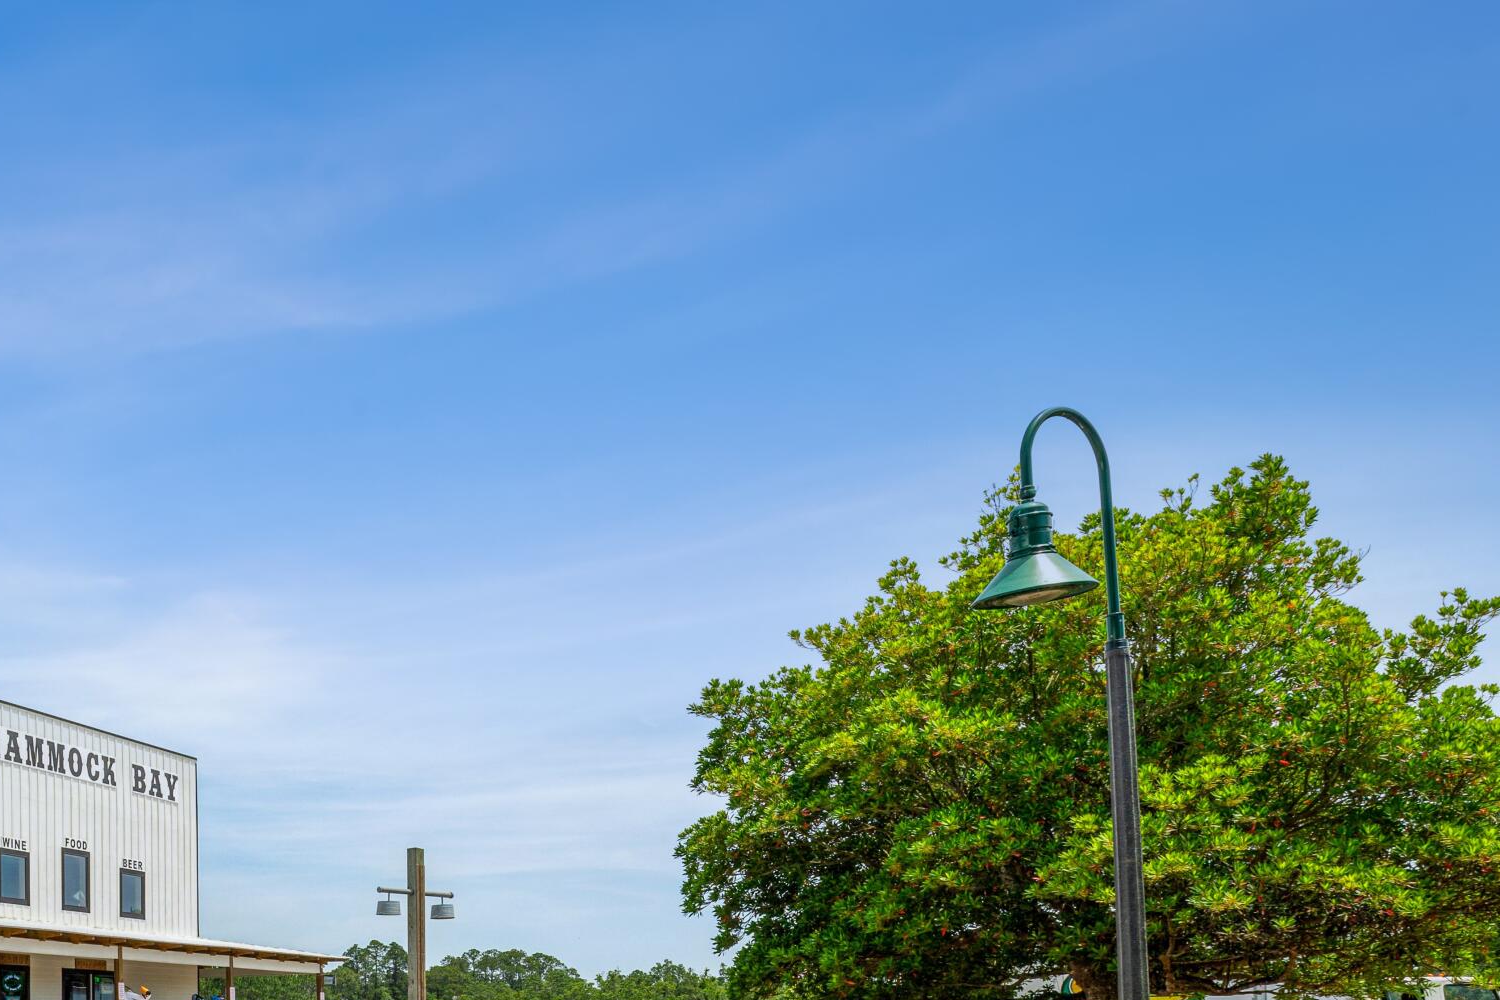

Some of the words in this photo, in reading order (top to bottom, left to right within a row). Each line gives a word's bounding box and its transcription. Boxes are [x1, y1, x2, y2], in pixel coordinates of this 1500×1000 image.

[131, 763, 179, 802] BAY
[2, 837, 27, 851] WINE
[65, 837, 88, 850] FOOD
[122, 858, 143, 871] BEER
